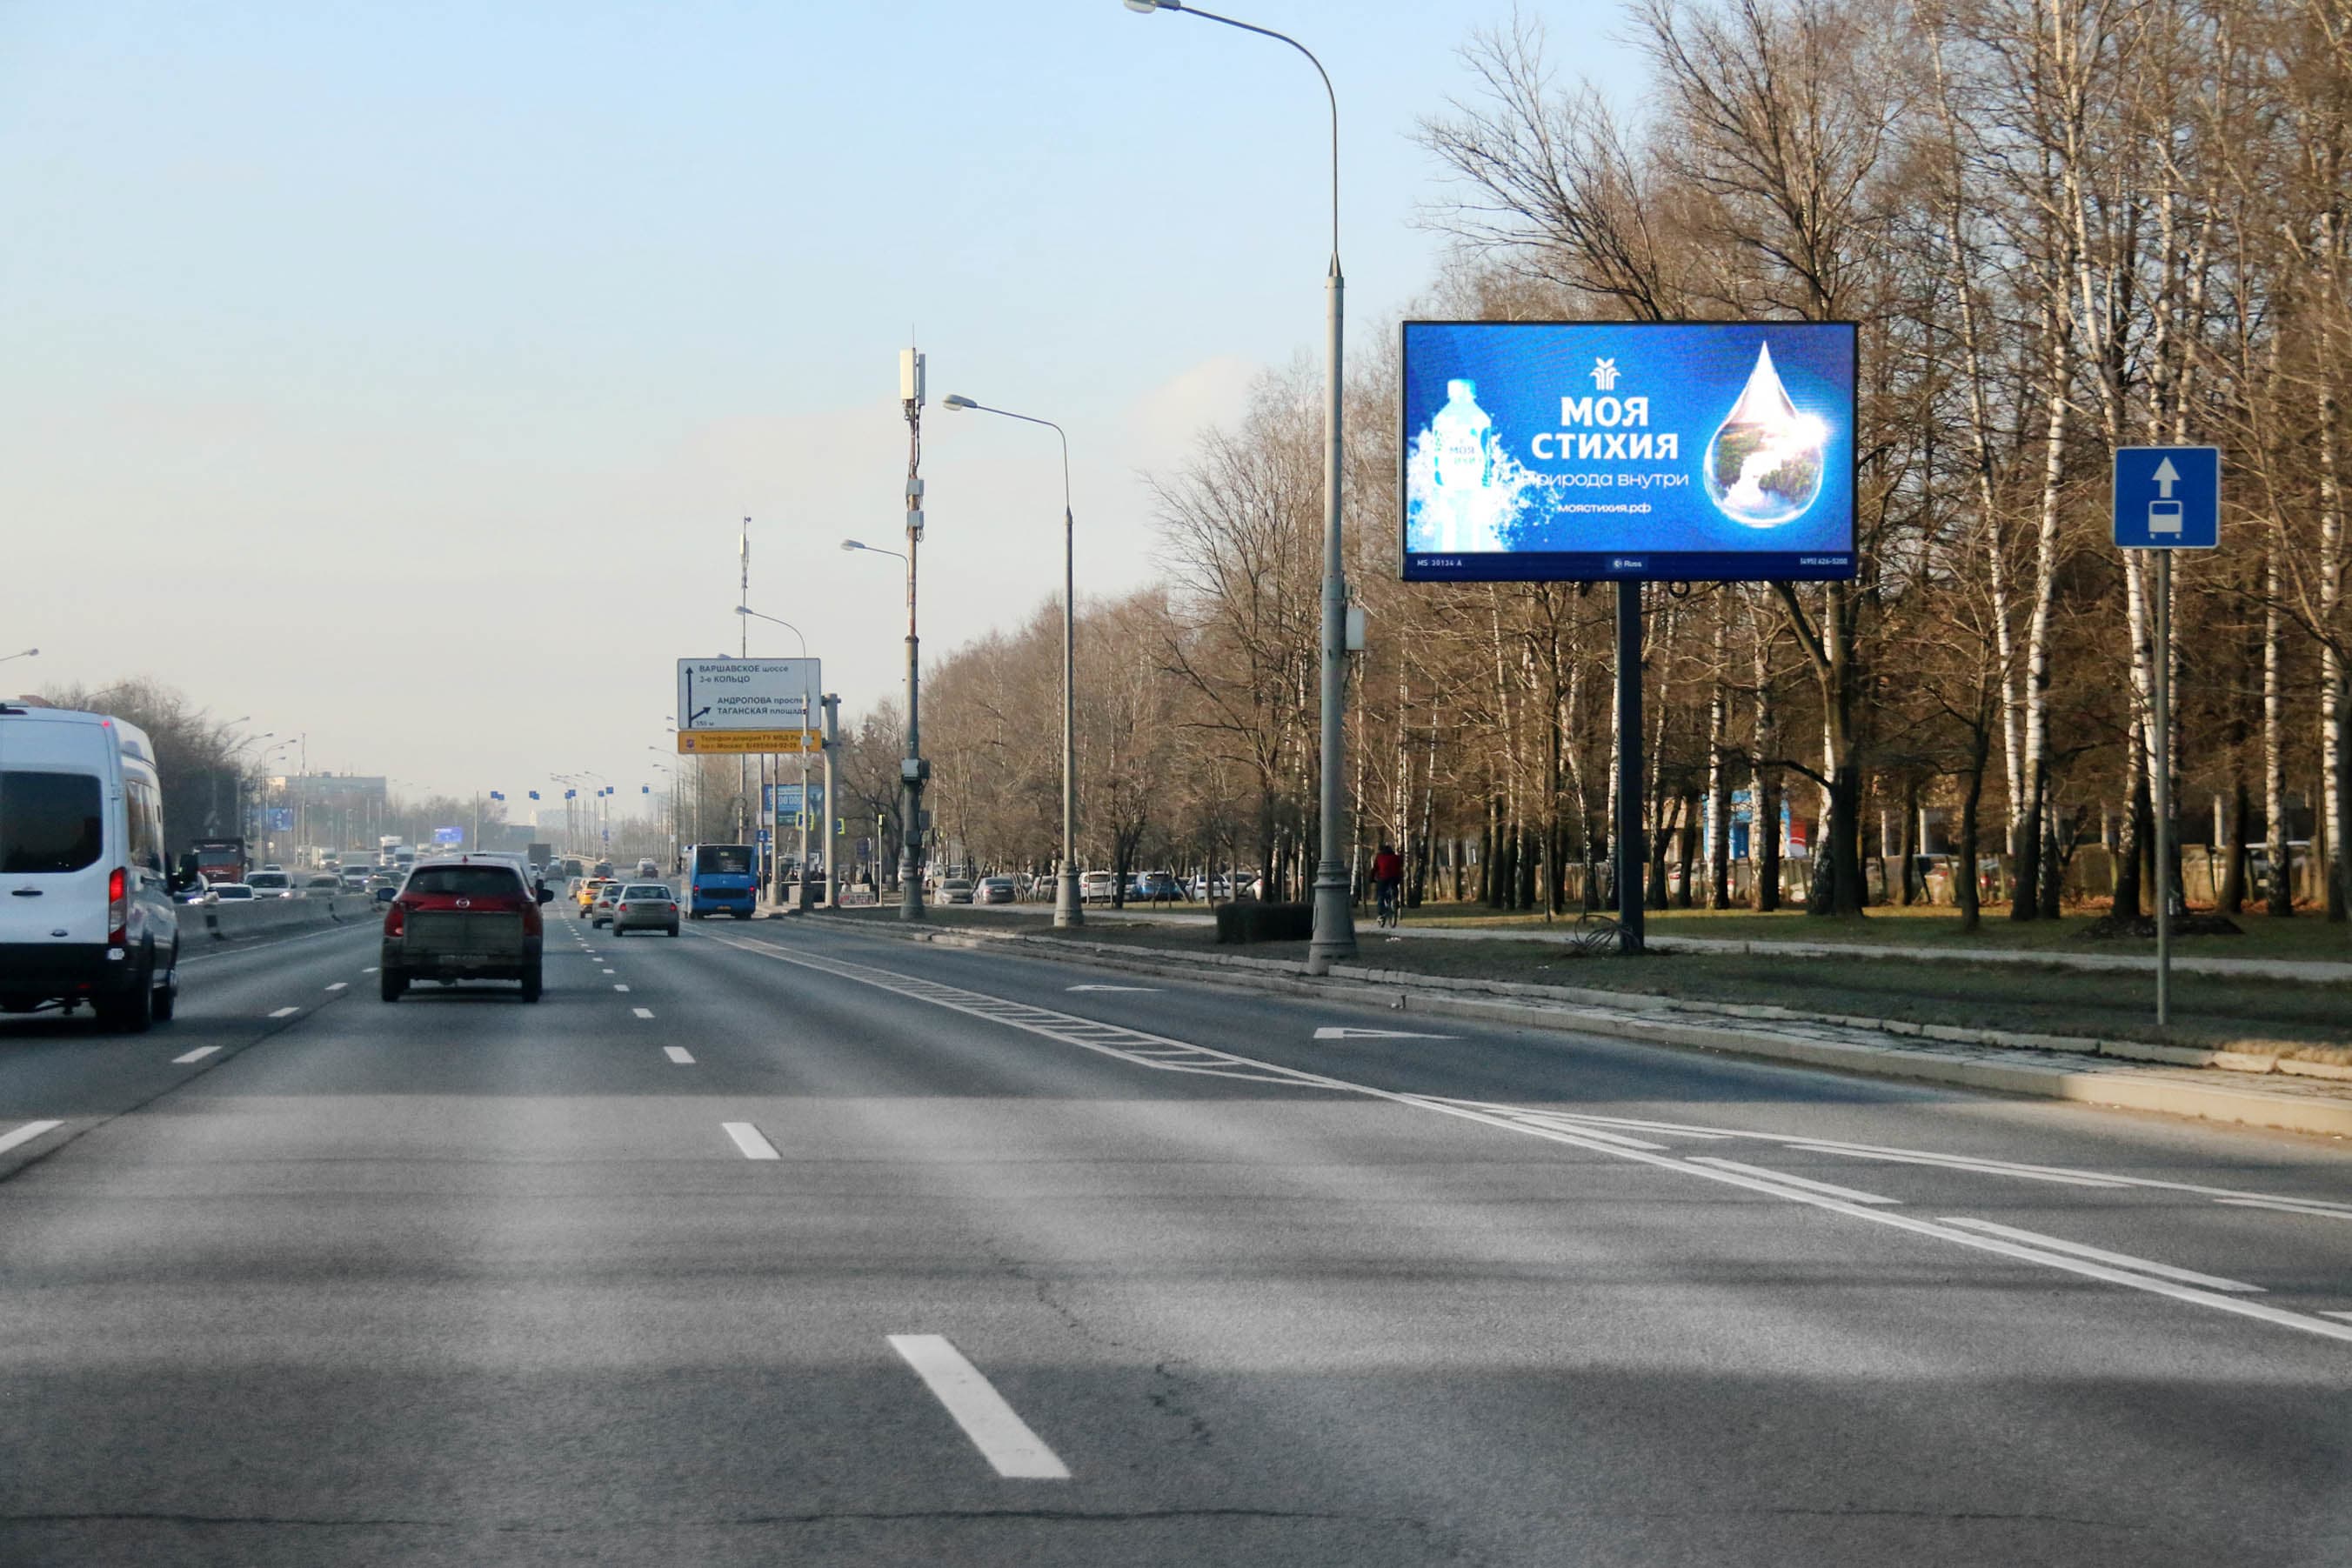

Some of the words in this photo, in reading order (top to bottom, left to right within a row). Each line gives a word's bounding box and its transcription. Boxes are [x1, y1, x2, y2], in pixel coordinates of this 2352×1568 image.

[1560, 397, 1649, 427] МОЯ
[1530, 432, 1679, 459] СТИХИЯ
[1527, 473, 1613, 487] рирода
[1617, 473, 1689, 488] внутри
[1558, 502, 1652, 514] моястихия.рф
[699, 664, 760, 673] ВАРШАВСКОЕ
[717, 697, 772, 705] АНДРОПОВА
